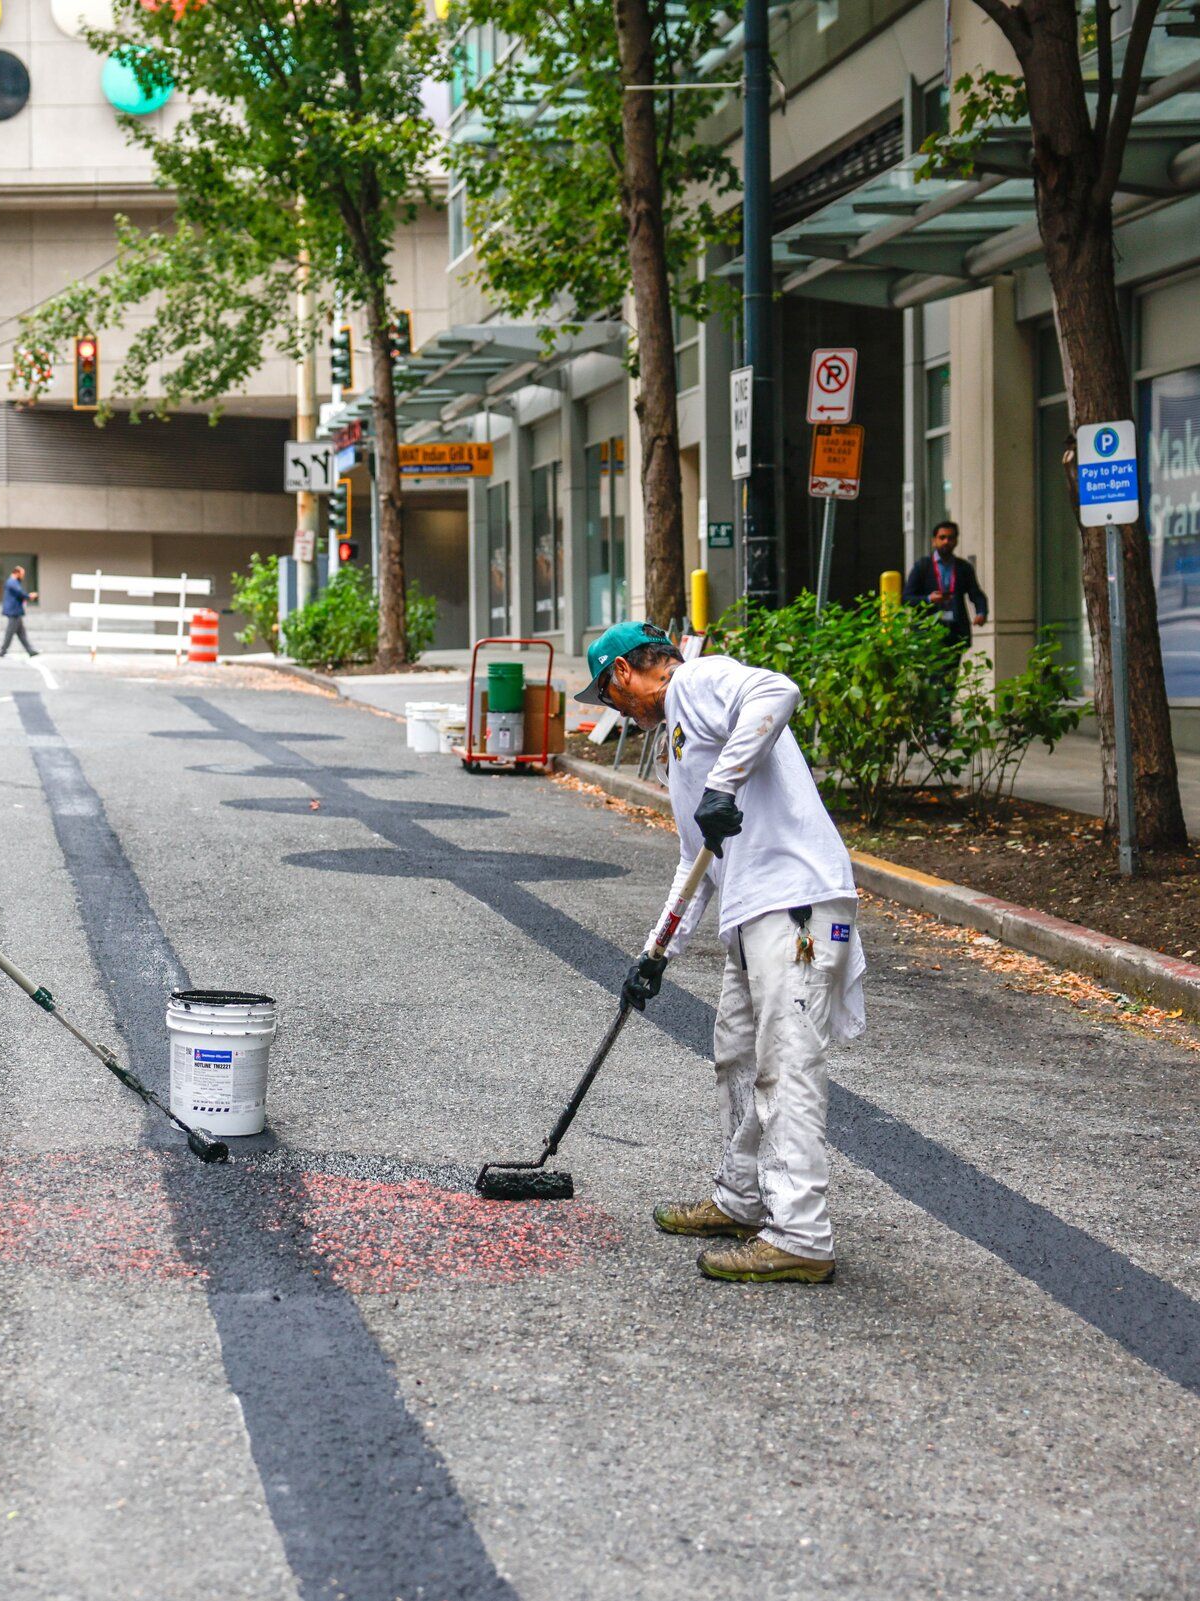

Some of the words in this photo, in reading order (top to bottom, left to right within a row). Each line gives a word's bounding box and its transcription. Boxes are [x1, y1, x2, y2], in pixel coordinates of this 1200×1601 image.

[734, 377, 749, 402] ONE
[734, 406, 749, 431] WAY
[1101, 433, 1114, 451] P
[1082, 468, 1098, 479] Pay
[1101, 467, 1110, 476] to
[1111, 464, 1133, 475] Park
[1086, 479, 1130, 492] 8am-8pm
